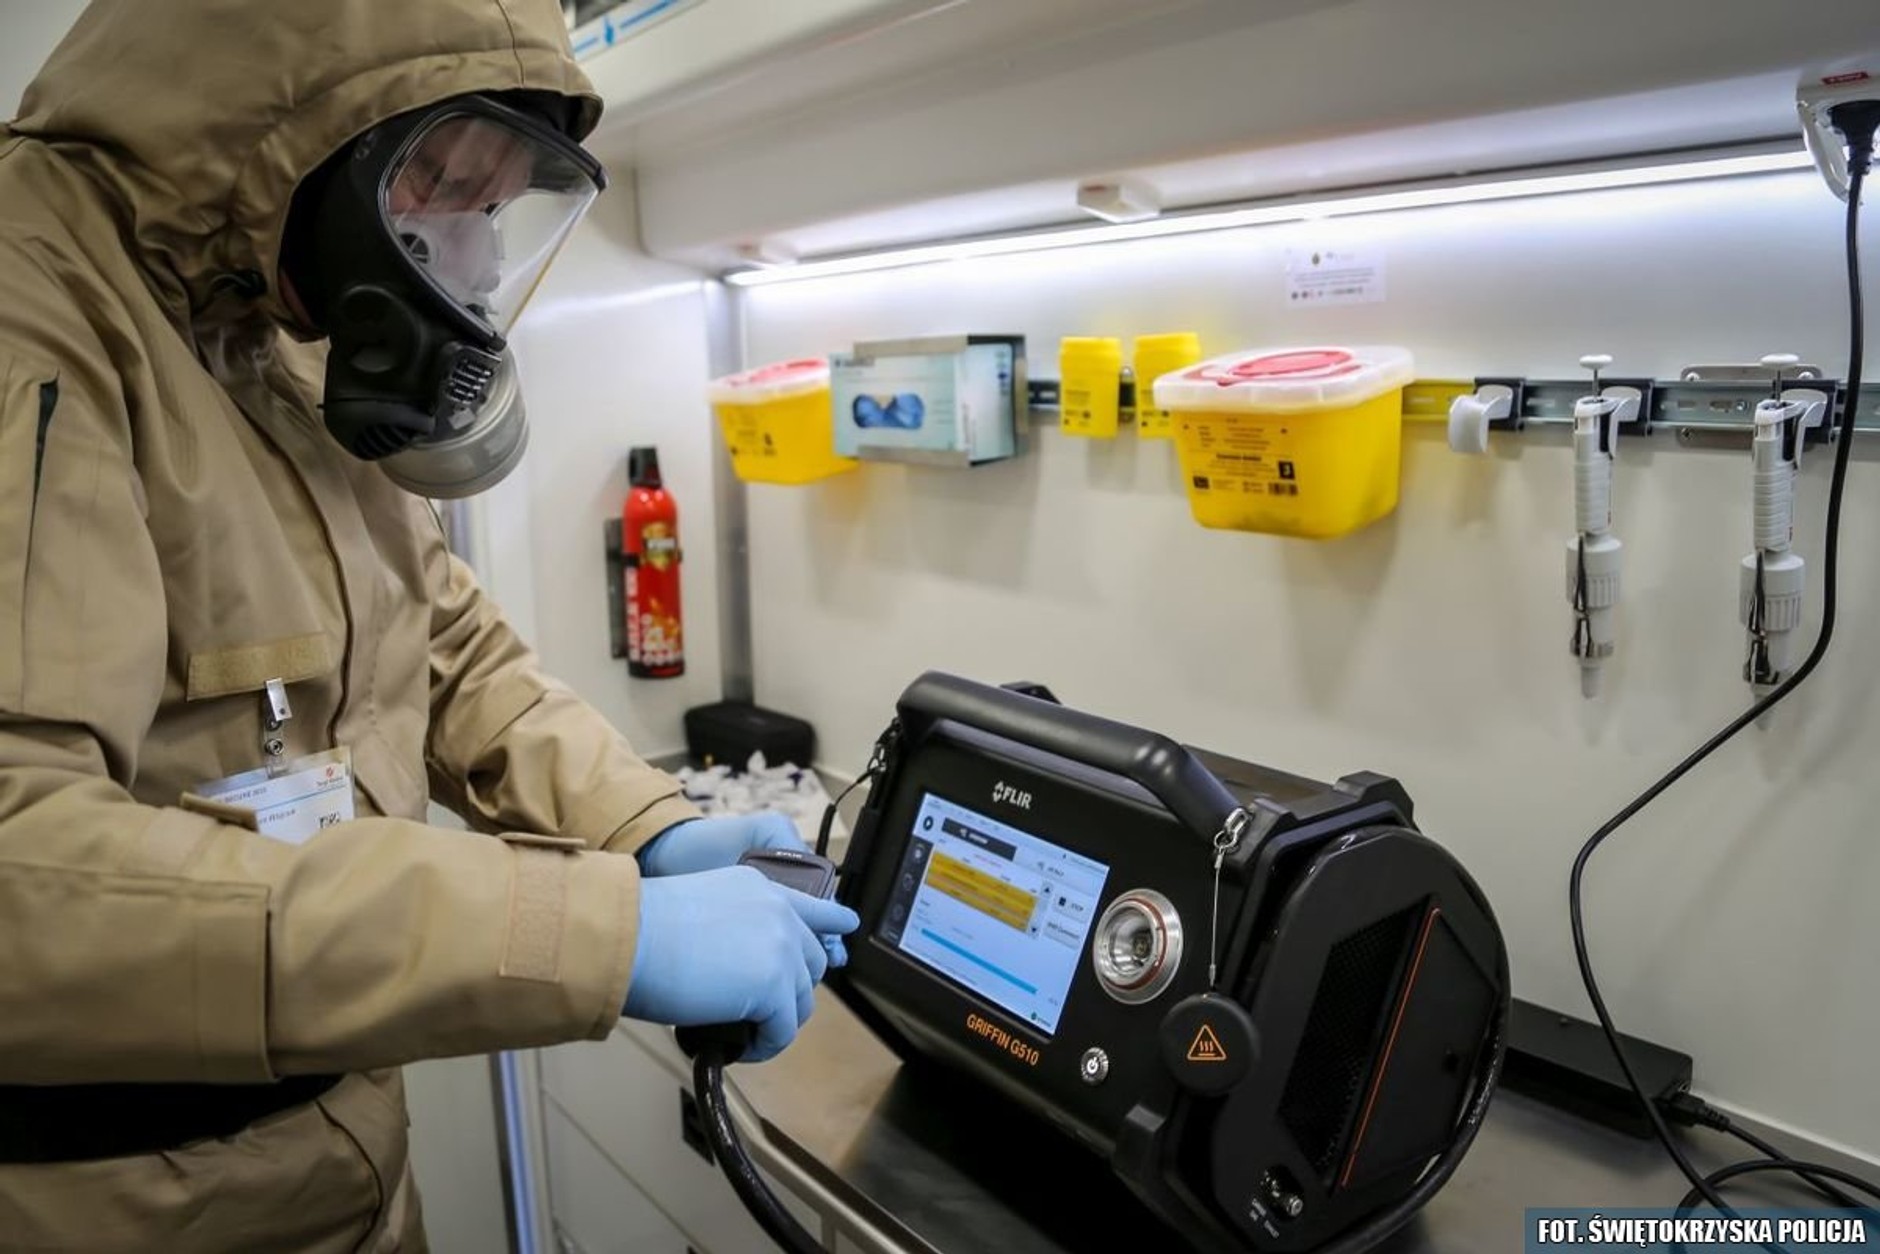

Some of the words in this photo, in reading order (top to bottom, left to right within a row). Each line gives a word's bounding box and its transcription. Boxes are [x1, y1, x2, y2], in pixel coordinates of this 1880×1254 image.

[1002, 784, 1032, 810] FLIR
[966, 1013, 1012, 1049] GRIFFIN
[1010, 1038, 1040, 1066] G510
